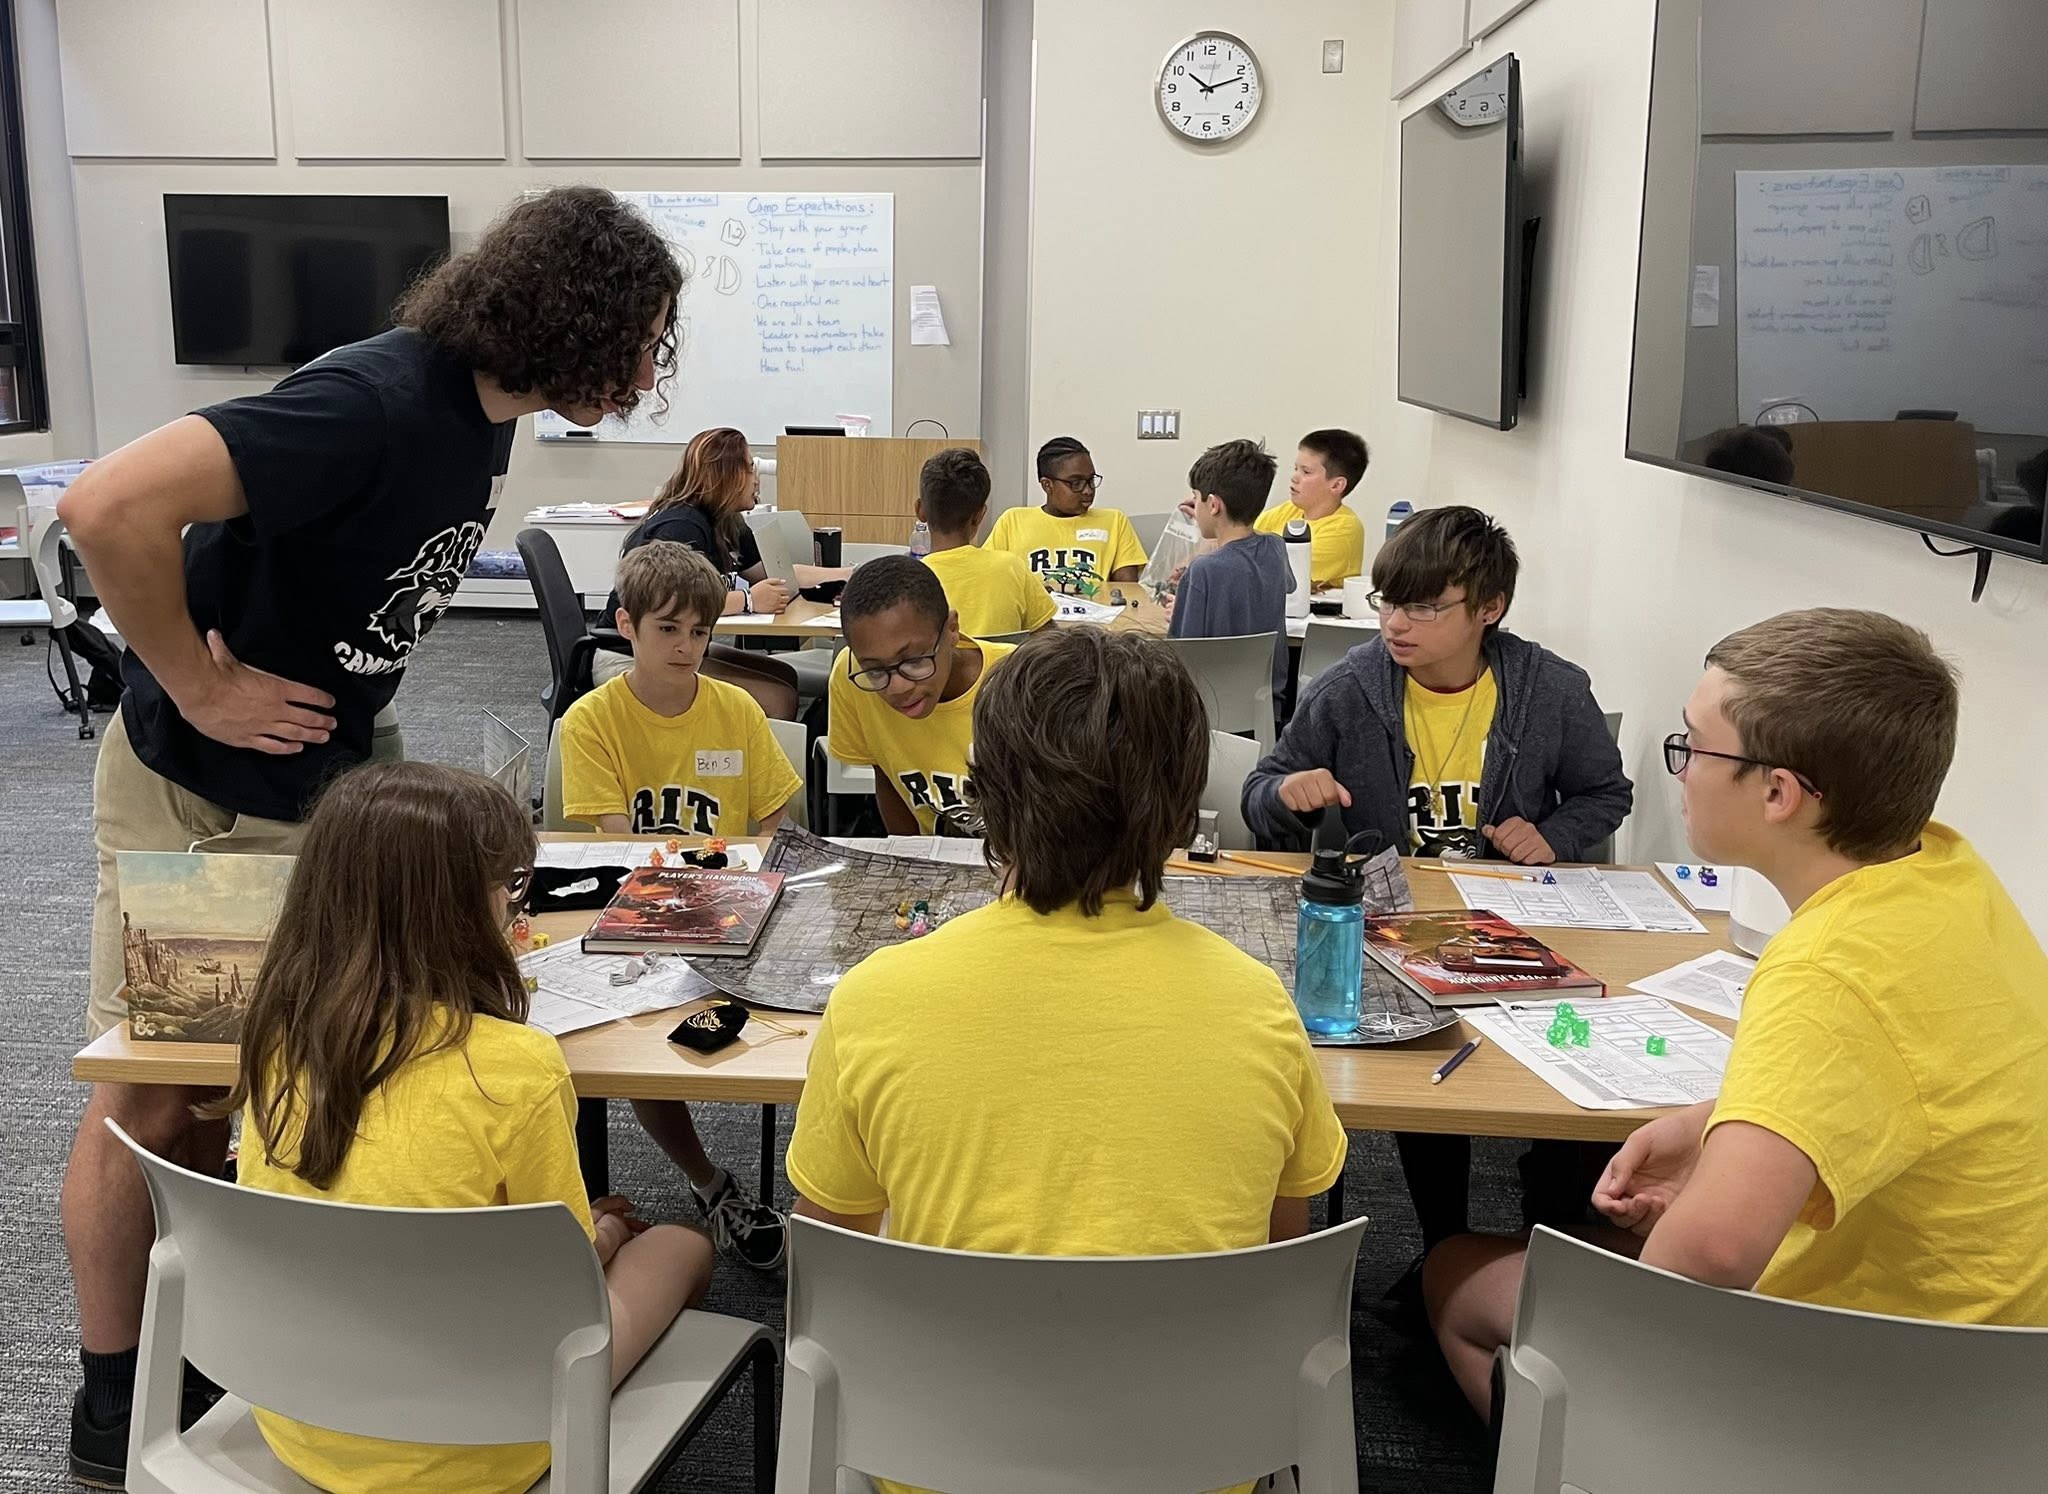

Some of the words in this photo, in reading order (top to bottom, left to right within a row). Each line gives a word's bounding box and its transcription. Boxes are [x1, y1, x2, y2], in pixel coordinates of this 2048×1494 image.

[1186, 51, 1194, 61] 11
[1203, 45, 1217, 56] 12
[1228, 50, 1232, 61] 1
[1173, 65, 1185, 76] 10
[1236, 64, 1246, 75] 2
[1167, 83, 1177, 94] 9
[1241, 82, 1249, 93] 3
[1171, 101, 1181, 112] 8
[1234, 100, 1244, 110] 4
[1183, 115, 1192, 126] 7
[1221, 114, 1231, 125] 5
[1202, 121, 1211, 132] 6
[747, 197, 779, 219] Camp
[727, 223, 743, 240] 12
[758, 218, 784, 240] Stay
[790, 218, 808, 233] with
[814, 225, 833, 238] your
[838, 225, 868, 239] group
[756, 242, 783, 256] Take
[786, 246, 806, 254] care
[813, 240, 823, 252] of
[756, 274, 786, 289] Listen
[790, 273, 808, 287] with
[812, 278, 826, 292] your
[852, 275, 866, 287] and
[867, 272, 890, 287] heart
[757, 293, 778, 309] One
[756, 314, 768, 327] We
[772, 319, 786, 327] are
[790, 313, 802, 327] all
[817, 314, 840, 327] team
[787, 341, 797, 352] to
[801, 344, 834, 355] support
[697, 757, 718, 771] Ben
[723, 756, 731, 770] S
[898, 769, 976, 812] RI
[631, 784, 722, 836] RIT
[658, 871, 703, 880] PLAYER'S
[705, 873, 761, 882] HANDBOOK
